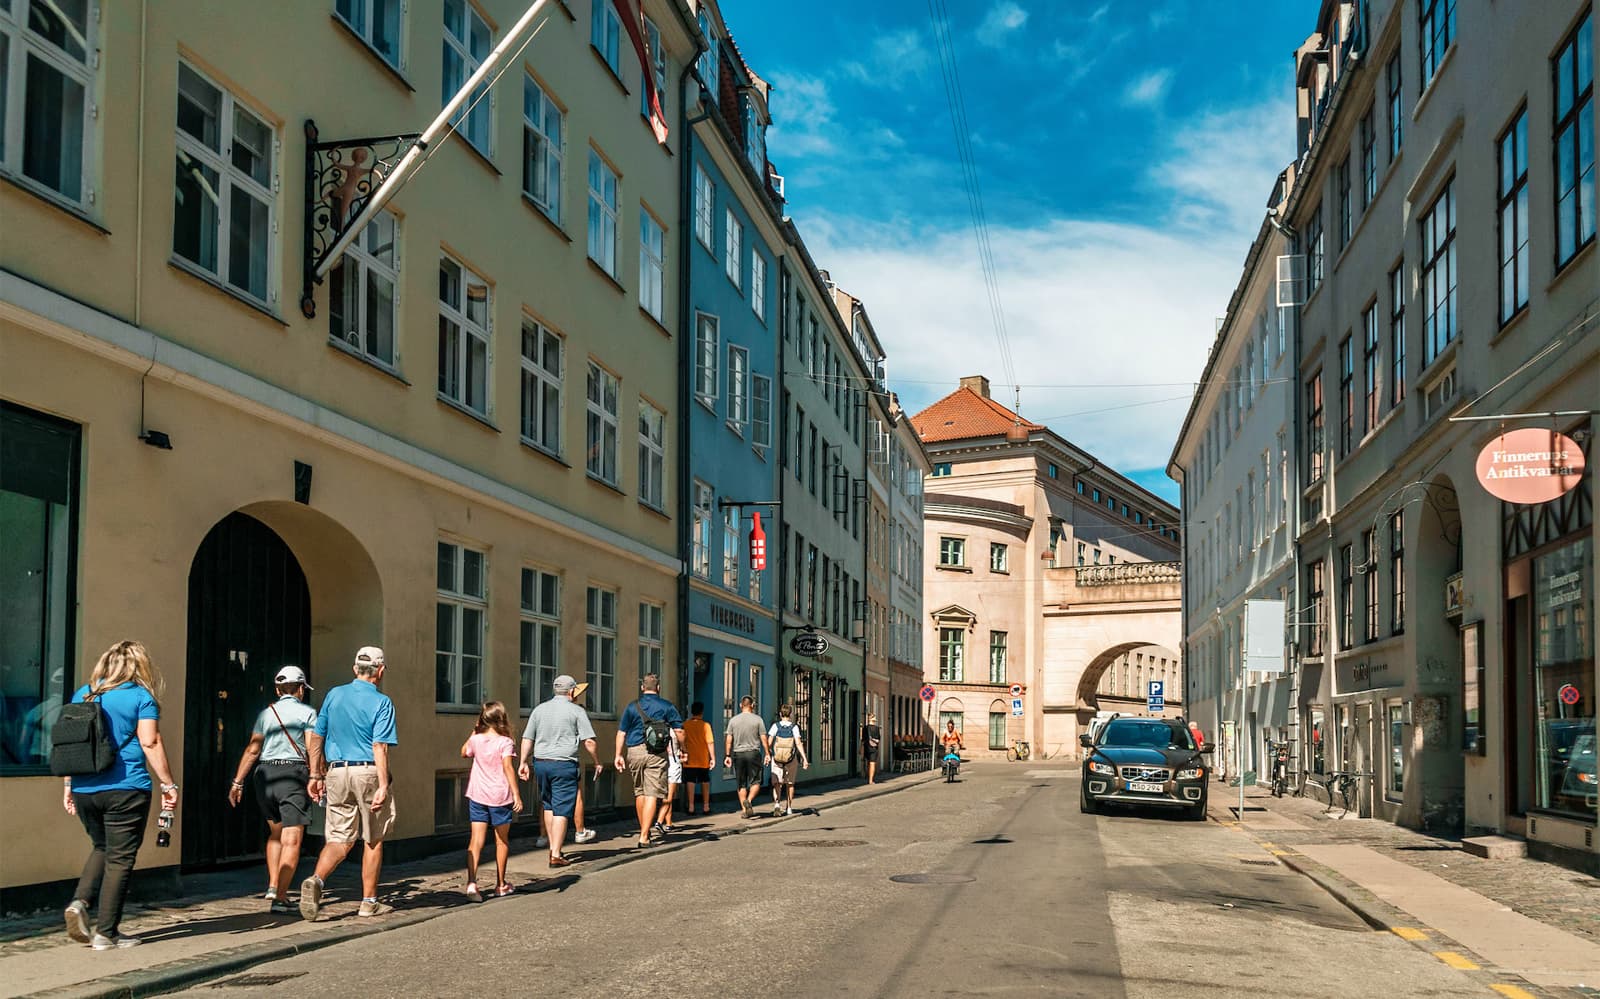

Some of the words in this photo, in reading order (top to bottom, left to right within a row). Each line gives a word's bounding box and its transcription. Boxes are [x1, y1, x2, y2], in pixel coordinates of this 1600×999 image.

[1493, 450, 1569, 465] Finnerups
[1486, 464, 1574, 479] Antikvariat
[1151, 682, 1160, 694] P
